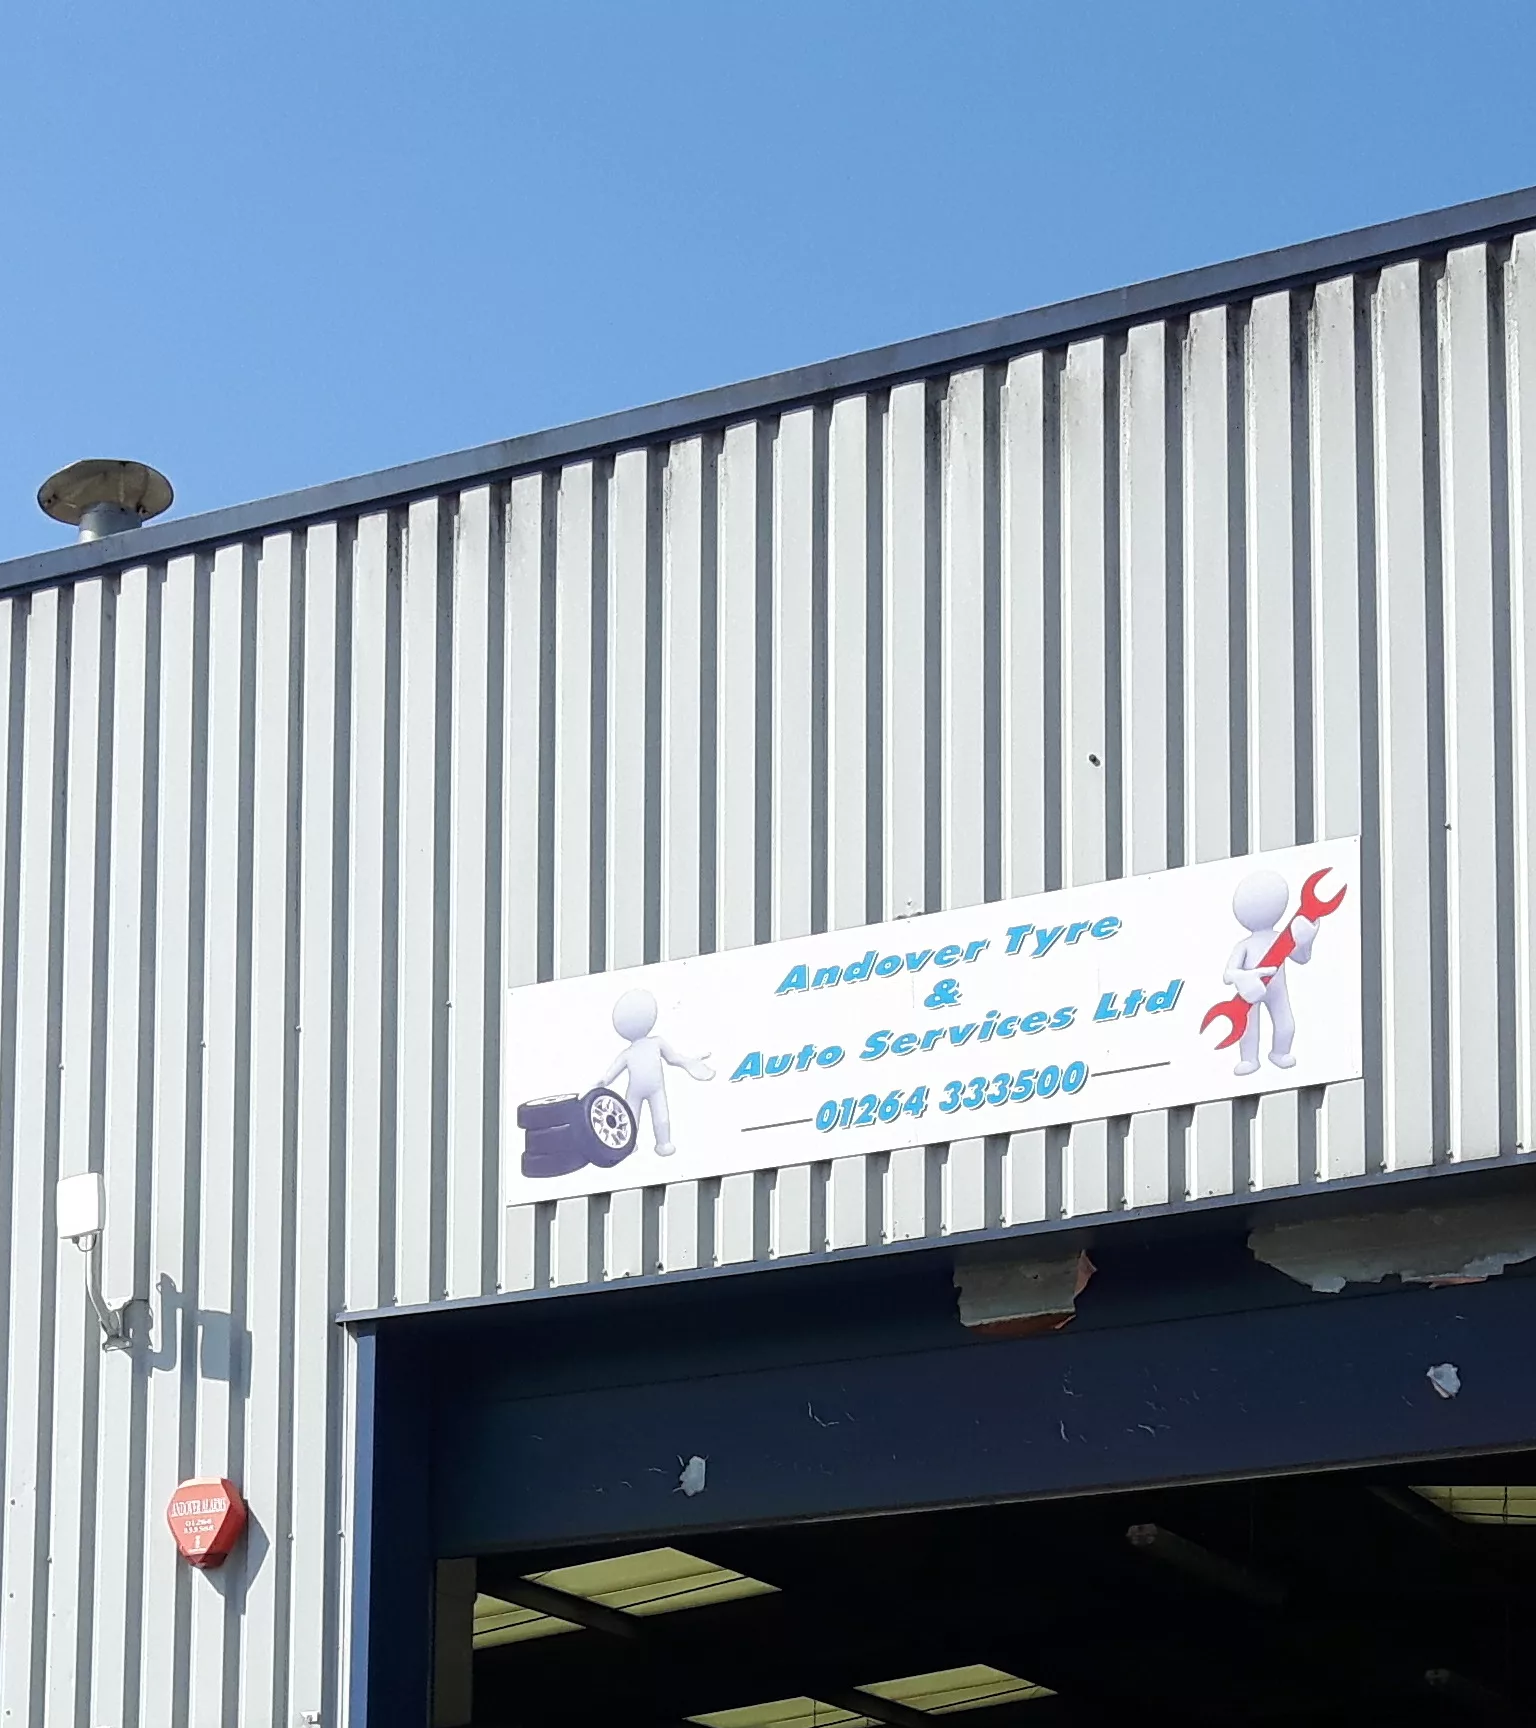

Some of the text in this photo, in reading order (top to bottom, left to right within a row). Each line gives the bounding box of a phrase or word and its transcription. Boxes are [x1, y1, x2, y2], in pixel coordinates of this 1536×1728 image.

[775, 914, 1123, 996] Andover Tyre
[923, 978, 961, 1009] &
[729, 978, 1185, 1083] Auto Services Ltd
[815, 1061, 1089, 1133] 01264 333500
